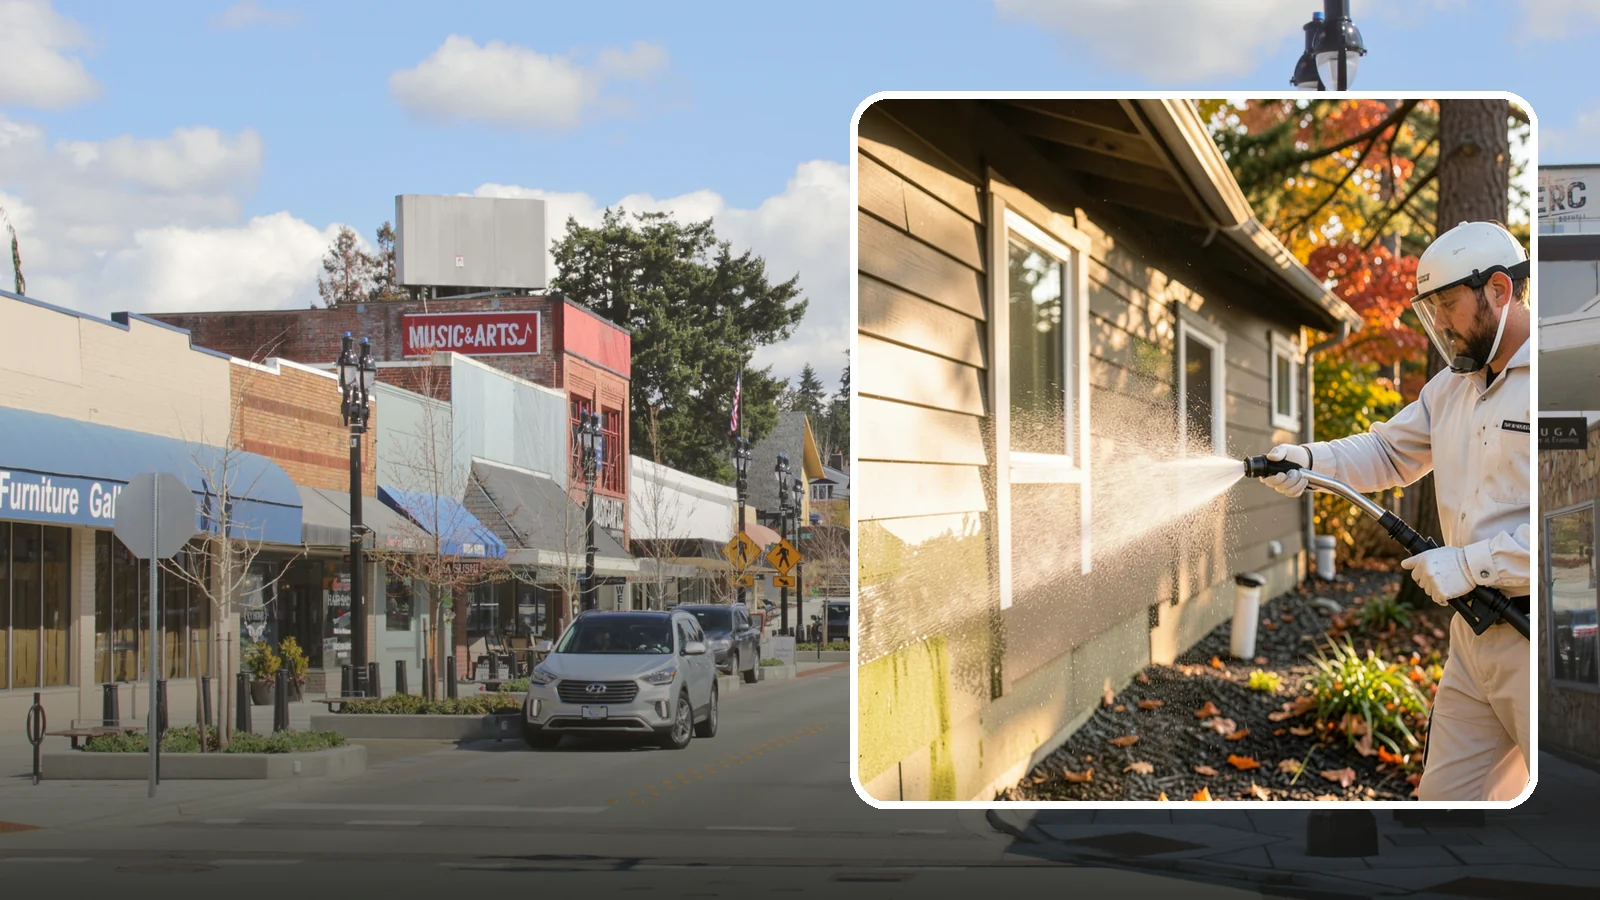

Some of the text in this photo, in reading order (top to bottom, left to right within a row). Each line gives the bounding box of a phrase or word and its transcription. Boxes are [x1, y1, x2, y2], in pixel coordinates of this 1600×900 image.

[1540, 427, 1577, 437] UGA
[0, 471, 122, 519] Furniture Gal
